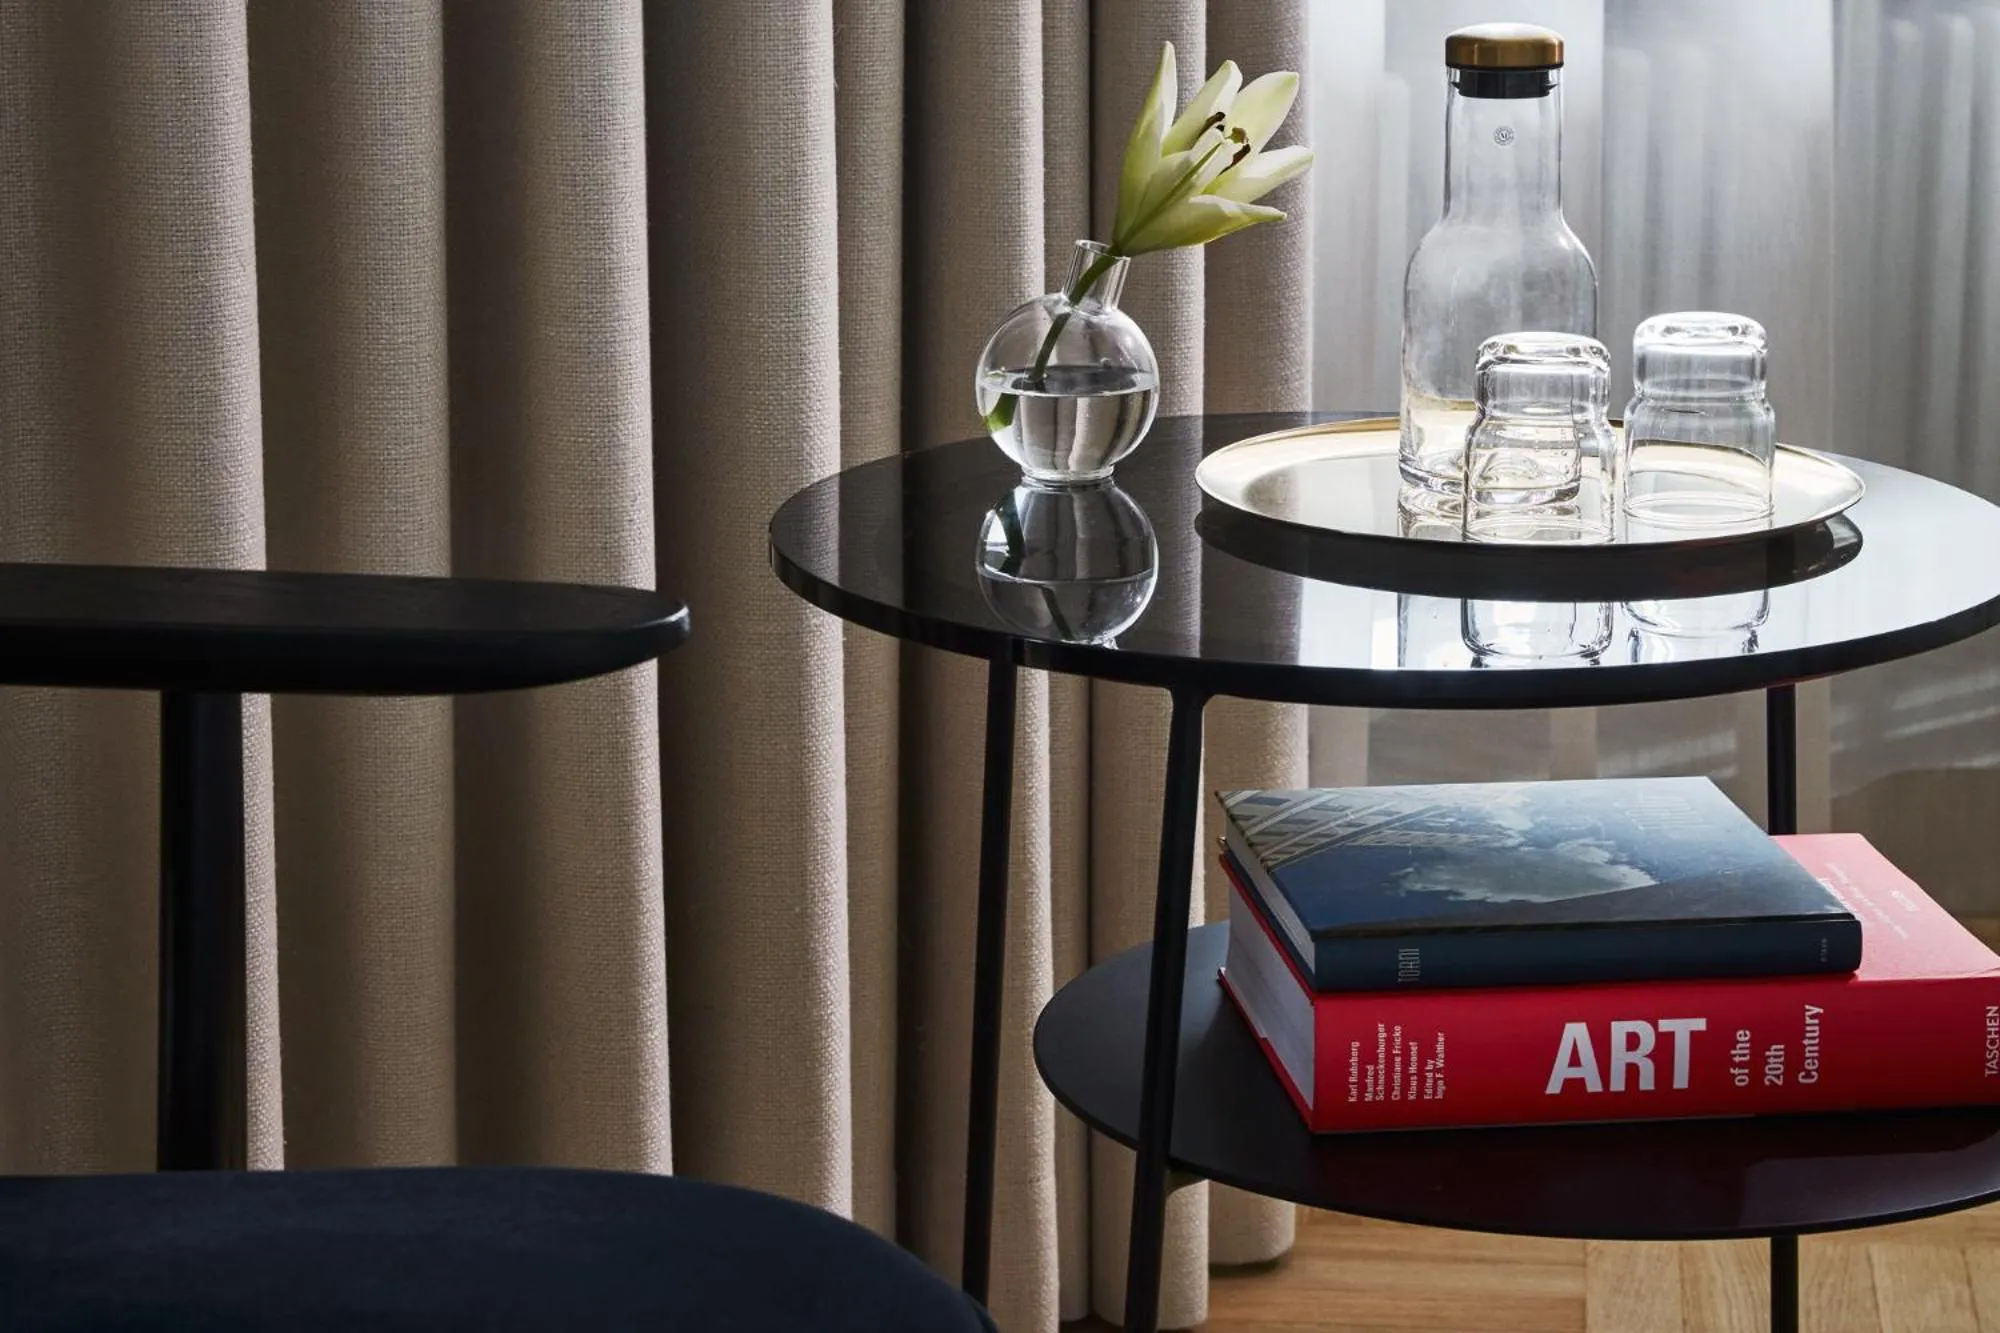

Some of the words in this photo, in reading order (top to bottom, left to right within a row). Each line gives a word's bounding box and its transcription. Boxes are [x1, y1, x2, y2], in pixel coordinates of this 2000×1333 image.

[1392, 1025, 1402, 1054] Fricke
[1436, 1032, 1445, 1068] Walther
[1544, 1018, 1707, 1095] ART
[1730, 1029, 1751, 1056] the
[1798, 1004, 1824, 1084] Century
[1984, 1005, 2000, 1078] TASCHEN
[1349, 1041, 1360, 1083] Ruhrberg
[1408, 1042, 1419, 1074] Honnef
[1425, 1059, 1435, 1069] by
[1763, 1043, 1785, 1087] 20th
[1364, 1064, 1375, 1102] Manfred
[1391, 1057, 1402, 1101] Christiane
[1408, 1075, 1417, 1100] Klaus
[1424, 1070, 1433, 1099] Edited
[1728, 1064, 1750, 1087] of
[1347, 1084, 1358, 1102] Karl
